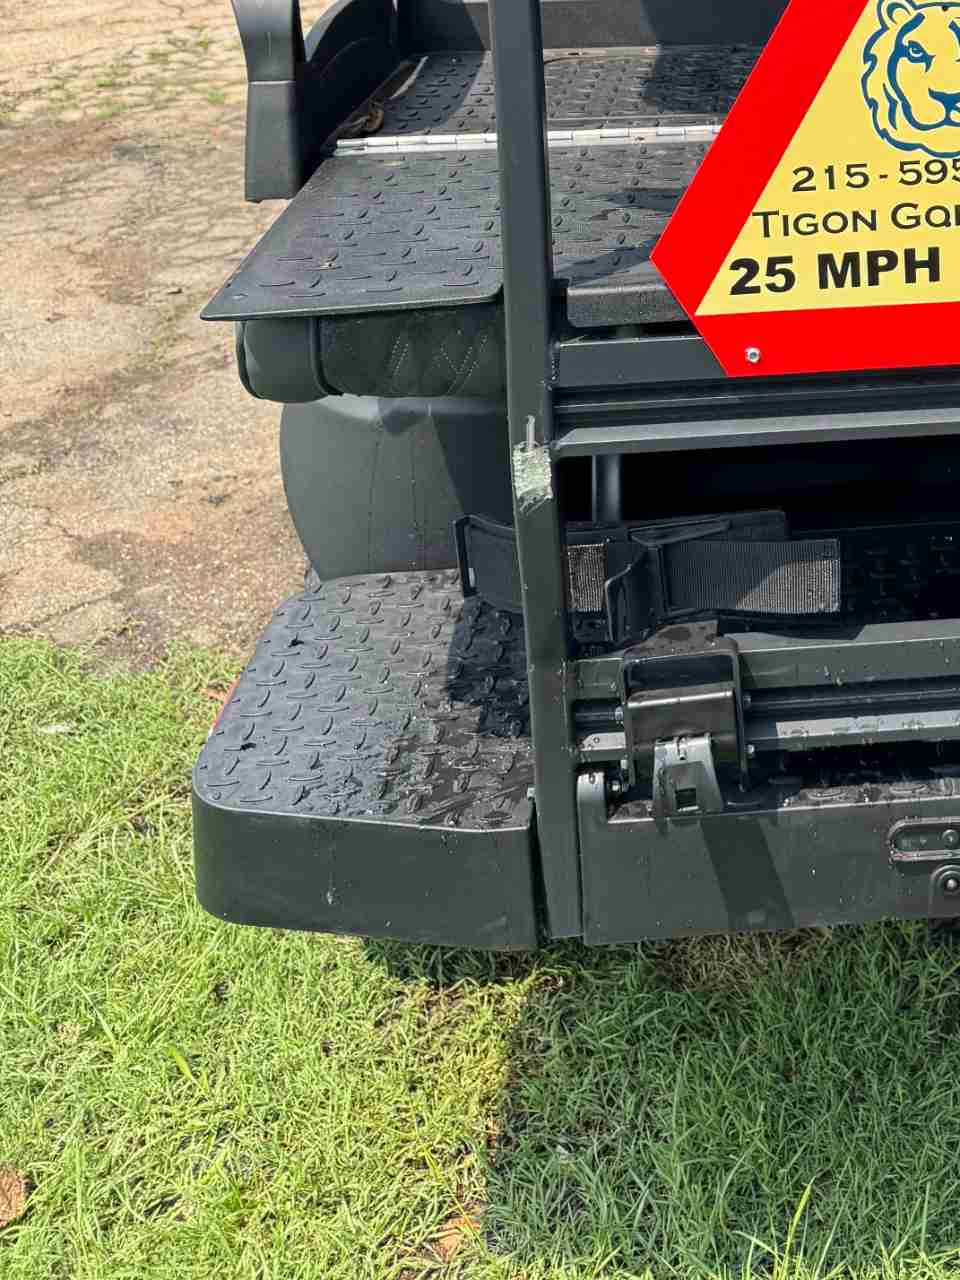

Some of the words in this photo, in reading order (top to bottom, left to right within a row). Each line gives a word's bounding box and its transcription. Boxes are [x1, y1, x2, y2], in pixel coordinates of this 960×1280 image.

[752, 209, 877, 238] TIGON
[729, 255, 797, 296] 25
[816, 246, 940, 290] MPH
